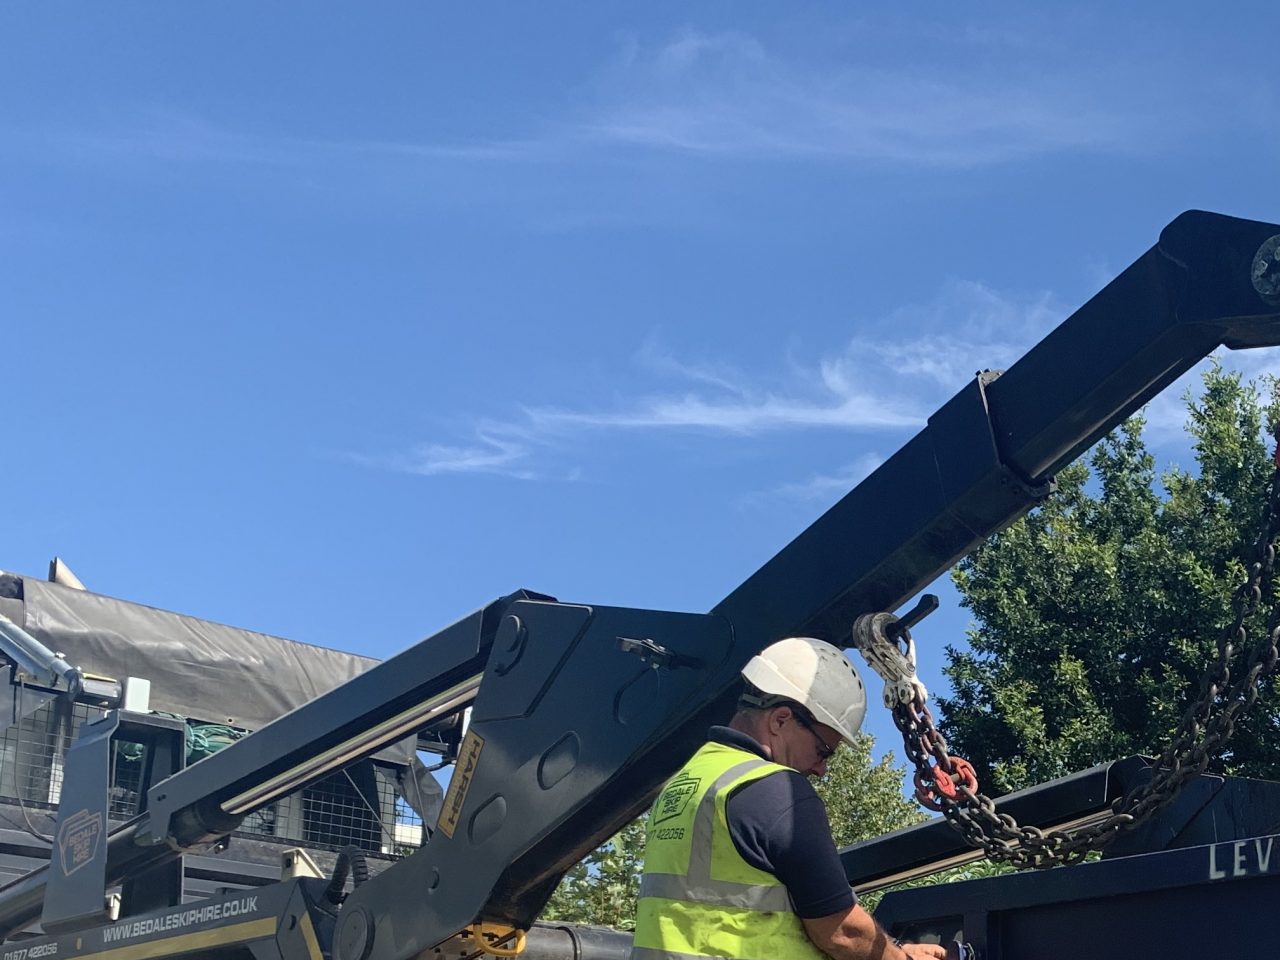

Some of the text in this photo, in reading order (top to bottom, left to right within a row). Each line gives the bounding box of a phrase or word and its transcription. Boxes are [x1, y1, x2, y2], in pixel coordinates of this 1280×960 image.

[447, 739, 481, 825] HARSH
[657, 828, 685, 840] 422056
[103, 895, 258, 943] WWW.BEDALESKIPHIRE.CO.UK
[28, 943, 58, 959] 422056
